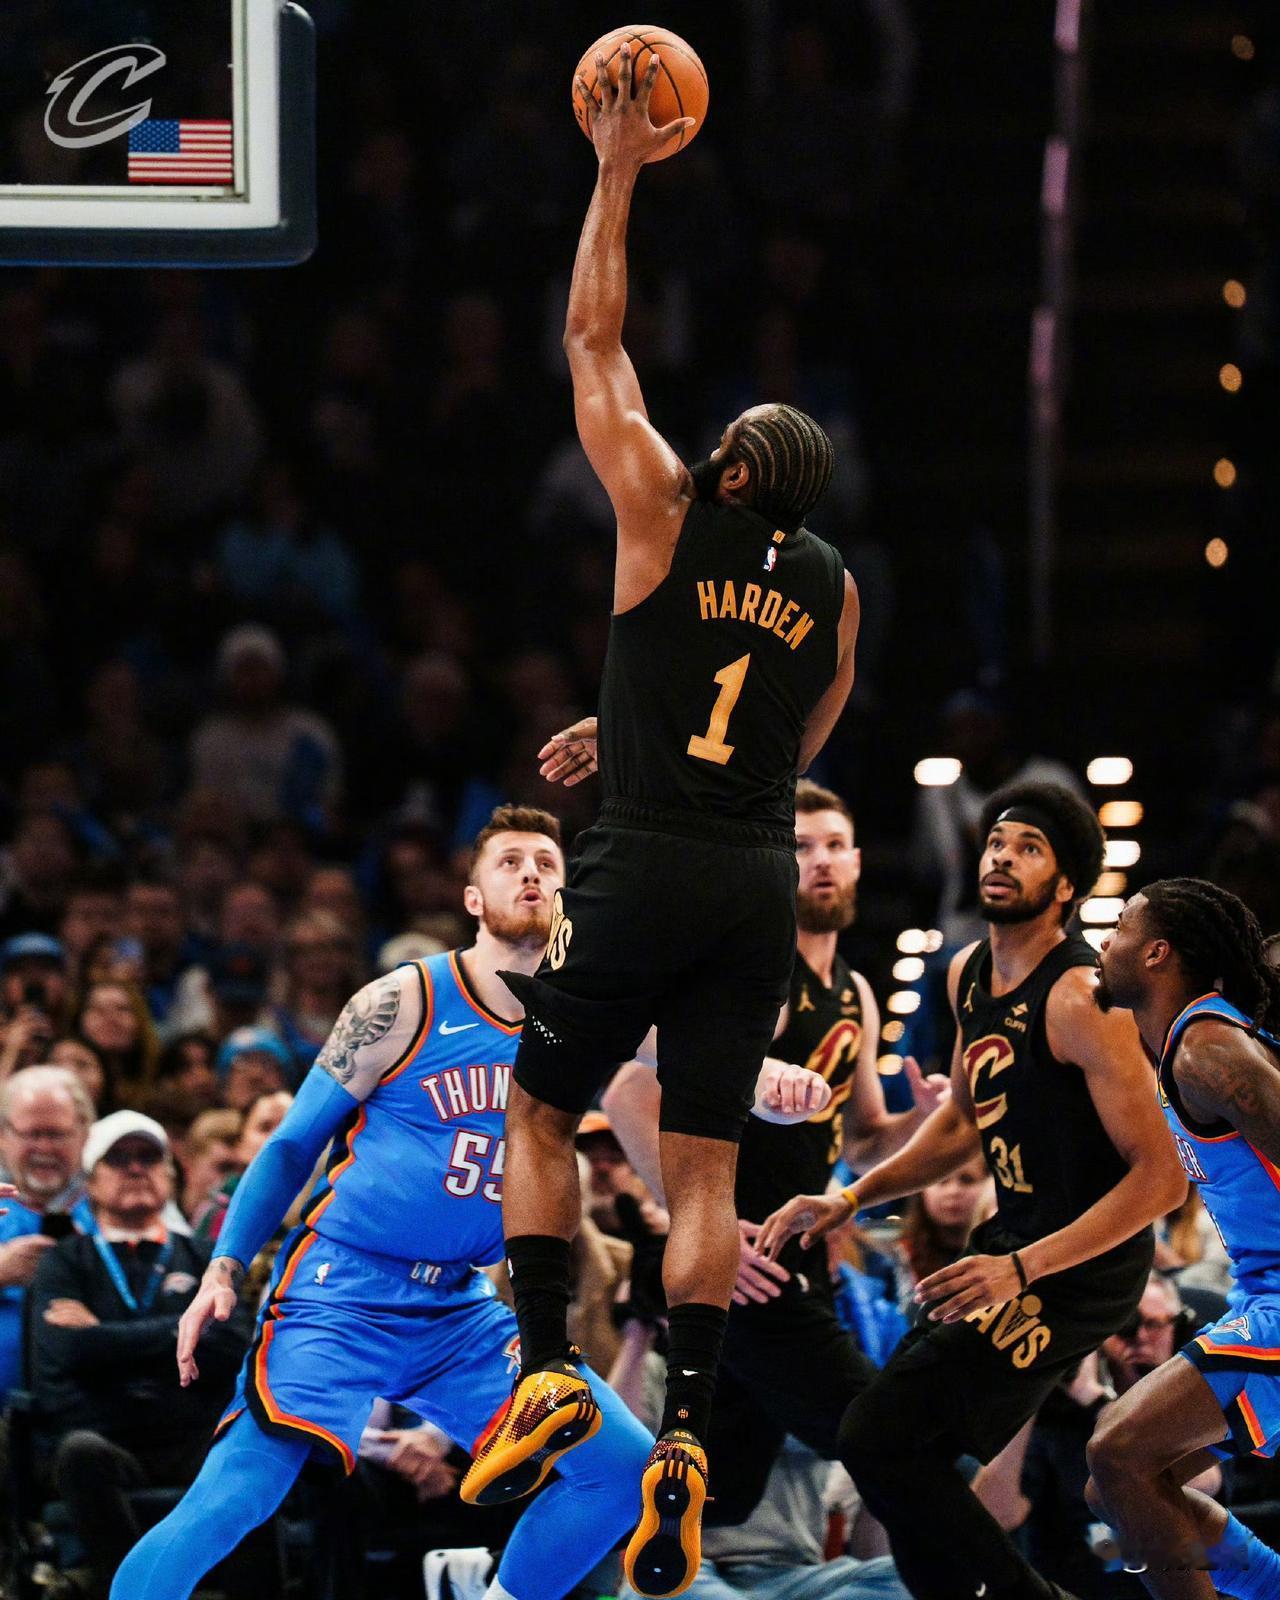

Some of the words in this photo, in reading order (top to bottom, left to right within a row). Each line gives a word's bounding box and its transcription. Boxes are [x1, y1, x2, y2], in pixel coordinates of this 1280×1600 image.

[696, 580, 815, 650] HARDEN
[686, 652, 751, 765] 1
[420, 1064, 512, 1123] THUN
[962, 1033, 1015, 1130] C
[990, 1136, 1033, 1194] 31
